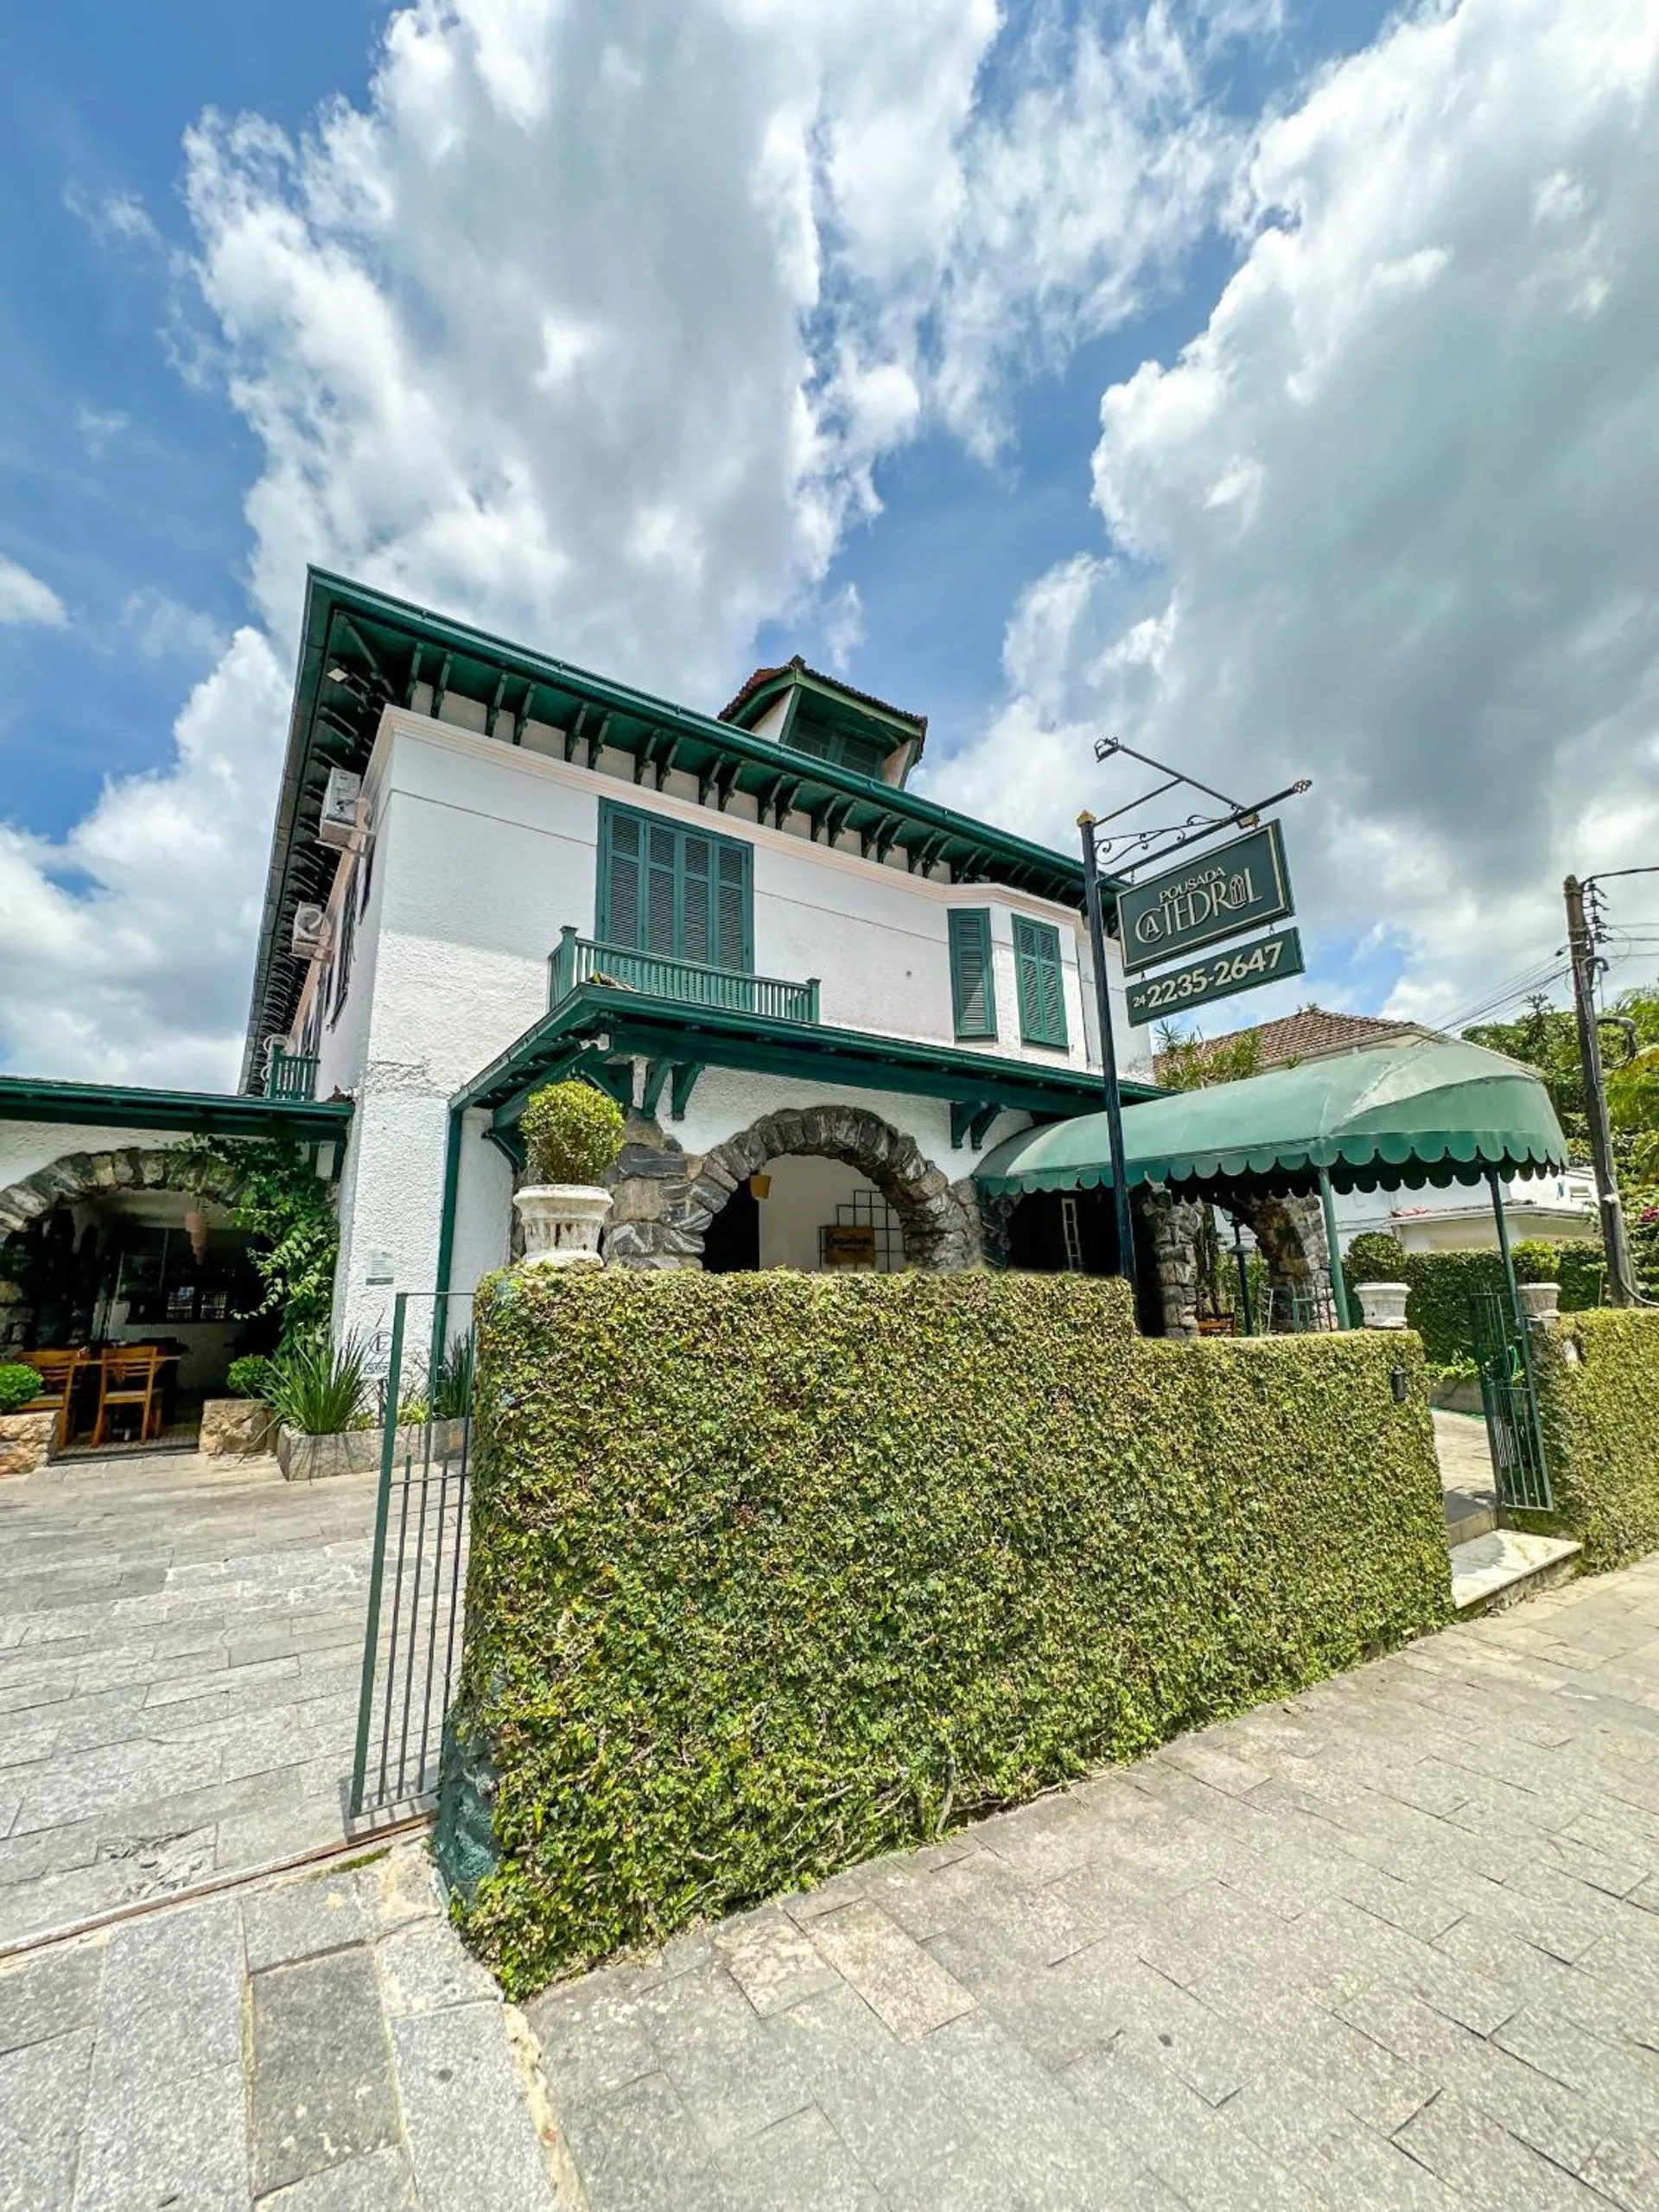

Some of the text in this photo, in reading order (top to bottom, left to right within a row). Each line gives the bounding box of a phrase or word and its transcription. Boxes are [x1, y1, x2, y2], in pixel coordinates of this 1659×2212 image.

[1160, 868, 1226, 903] POUSADA
[1133, 942, 1283, 1007] 24 2235-2647
